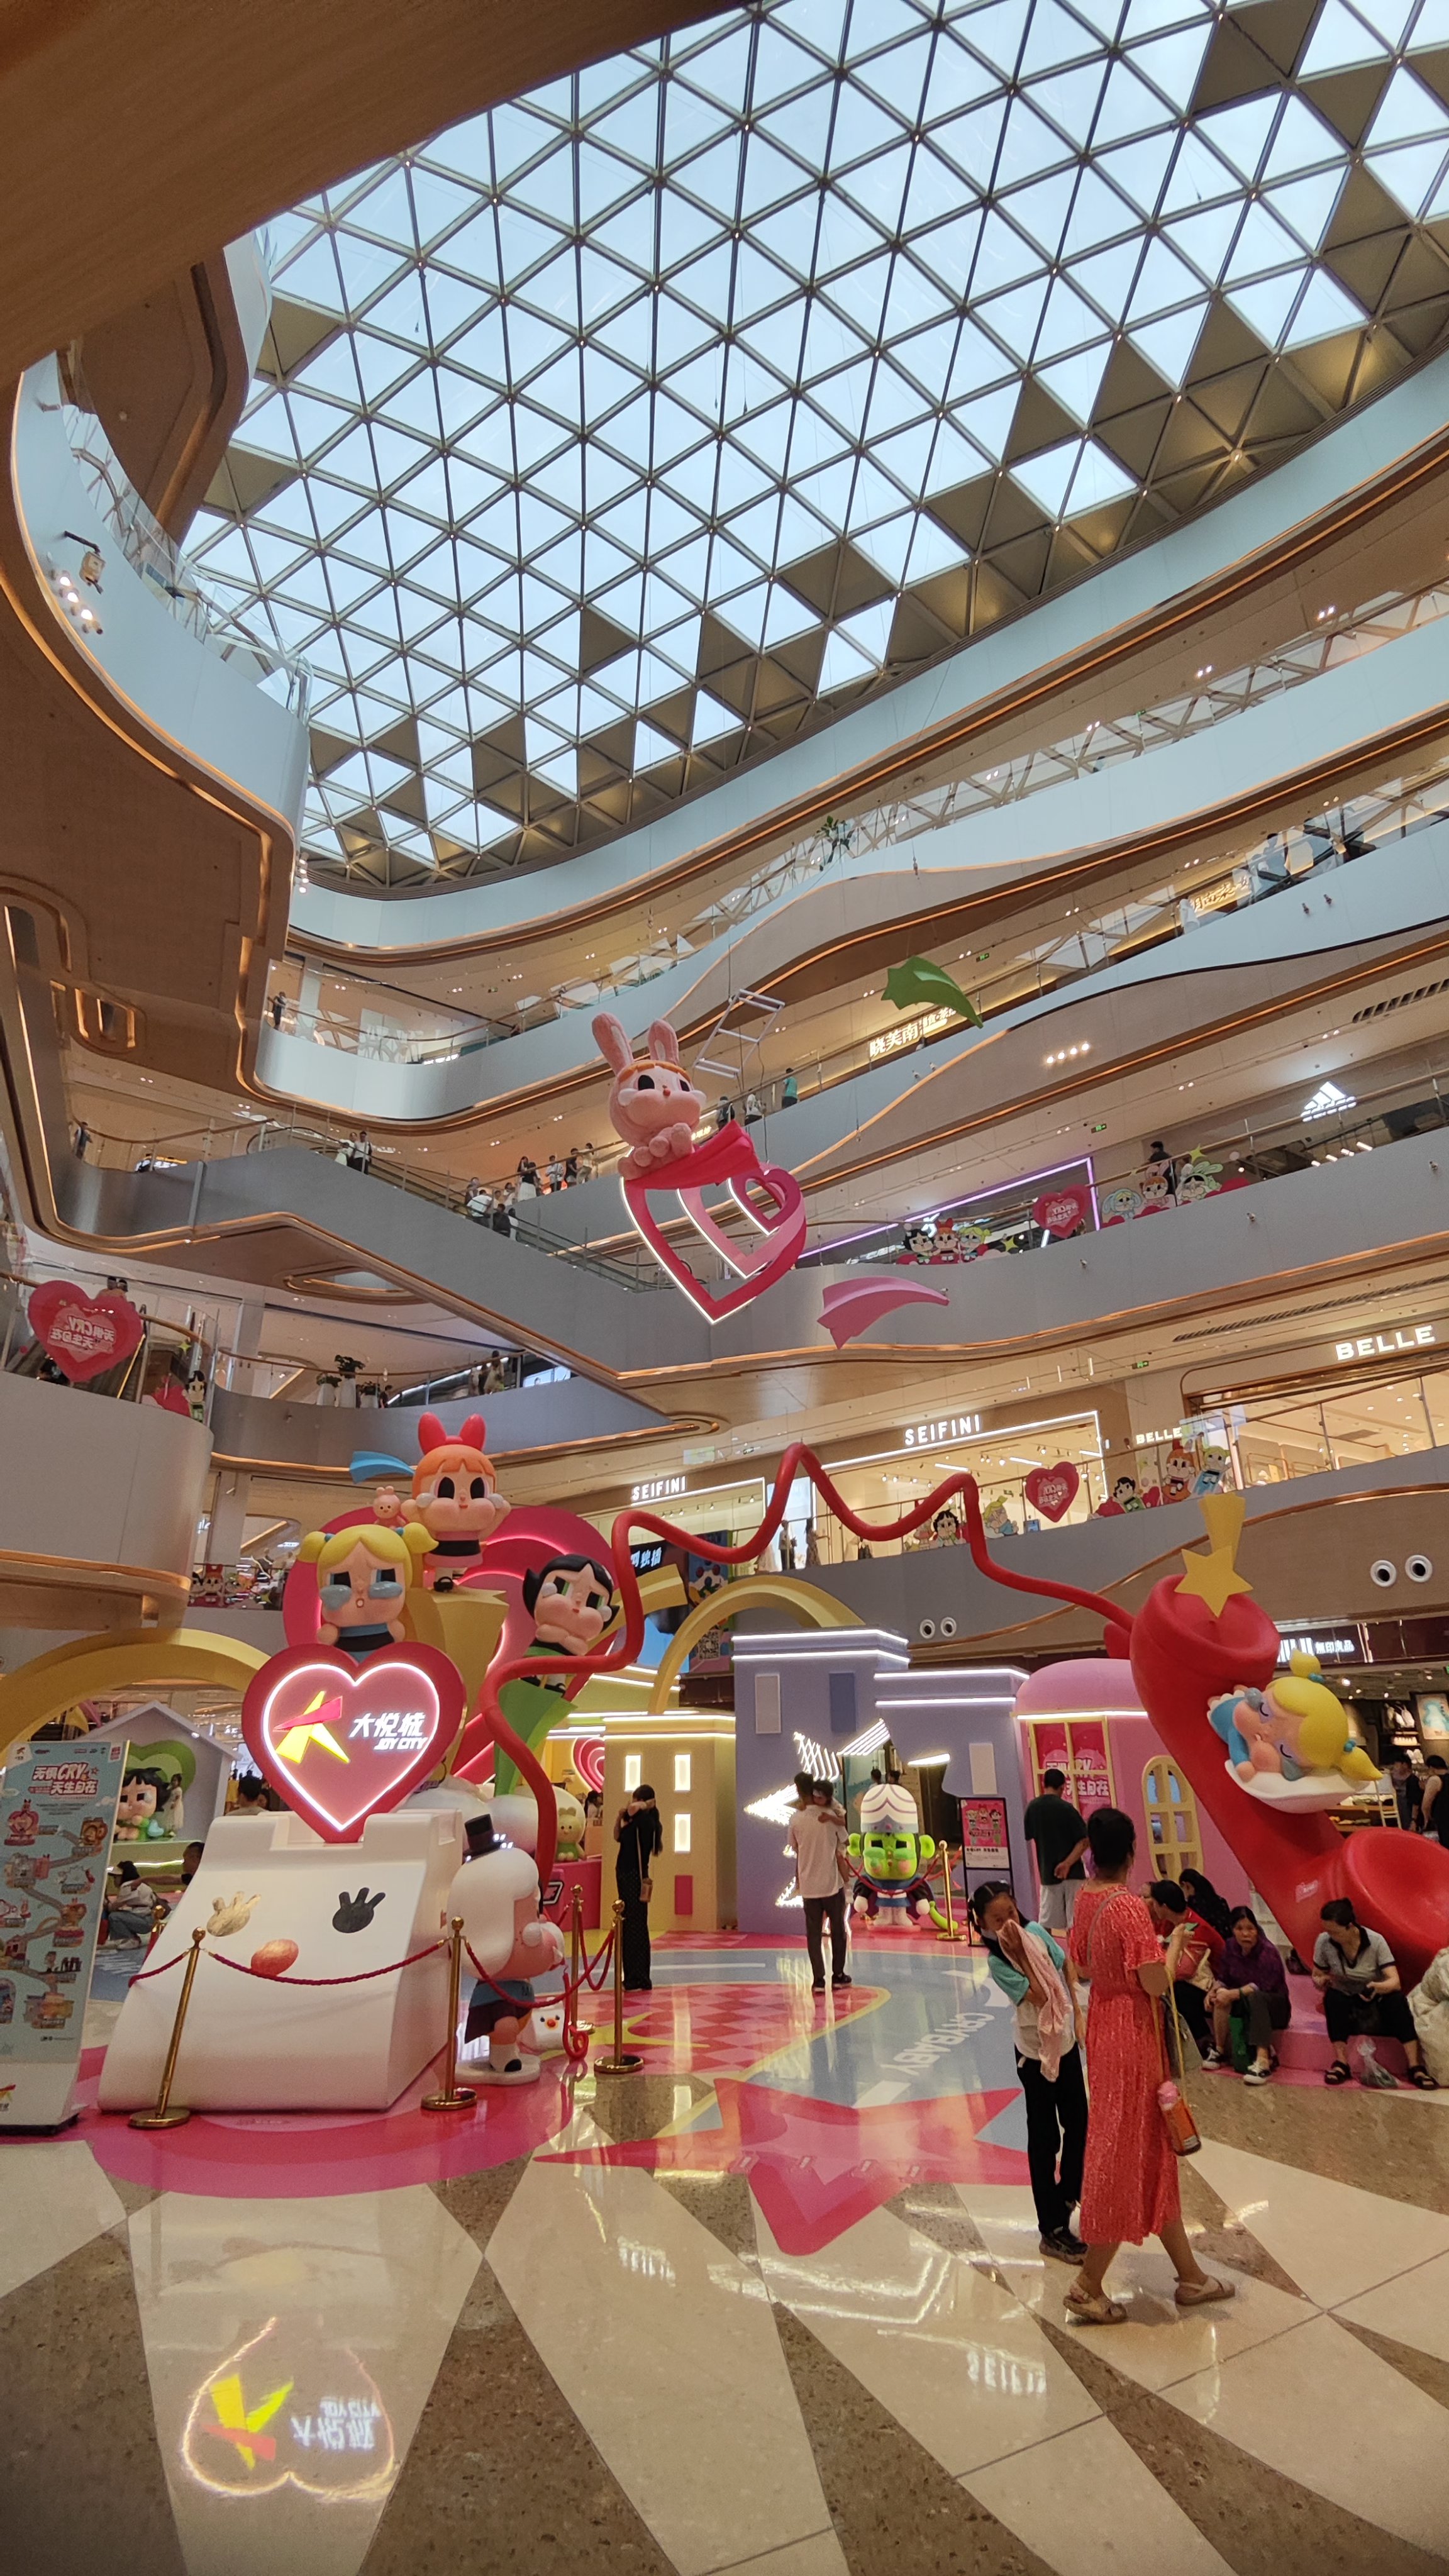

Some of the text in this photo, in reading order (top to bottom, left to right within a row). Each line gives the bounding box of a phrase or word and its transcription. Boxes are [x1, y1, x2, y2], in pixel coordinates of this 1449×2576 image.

[1335, 1325, 1436, 1360] BELLE
[904, 1414, 980, 1445] SEIFINI
[1136, 1427, 1182, 1444] BELLE
[631, 1476, 686, 1501] SEIFINI
[348, 1713, 426, 1738] 大悦城
[374, 1736, 428, 1750] JOY CITY
[51, 1781, 97, 1794] 天生自在
[880, 2012, 995, 2075] CRYBABY
